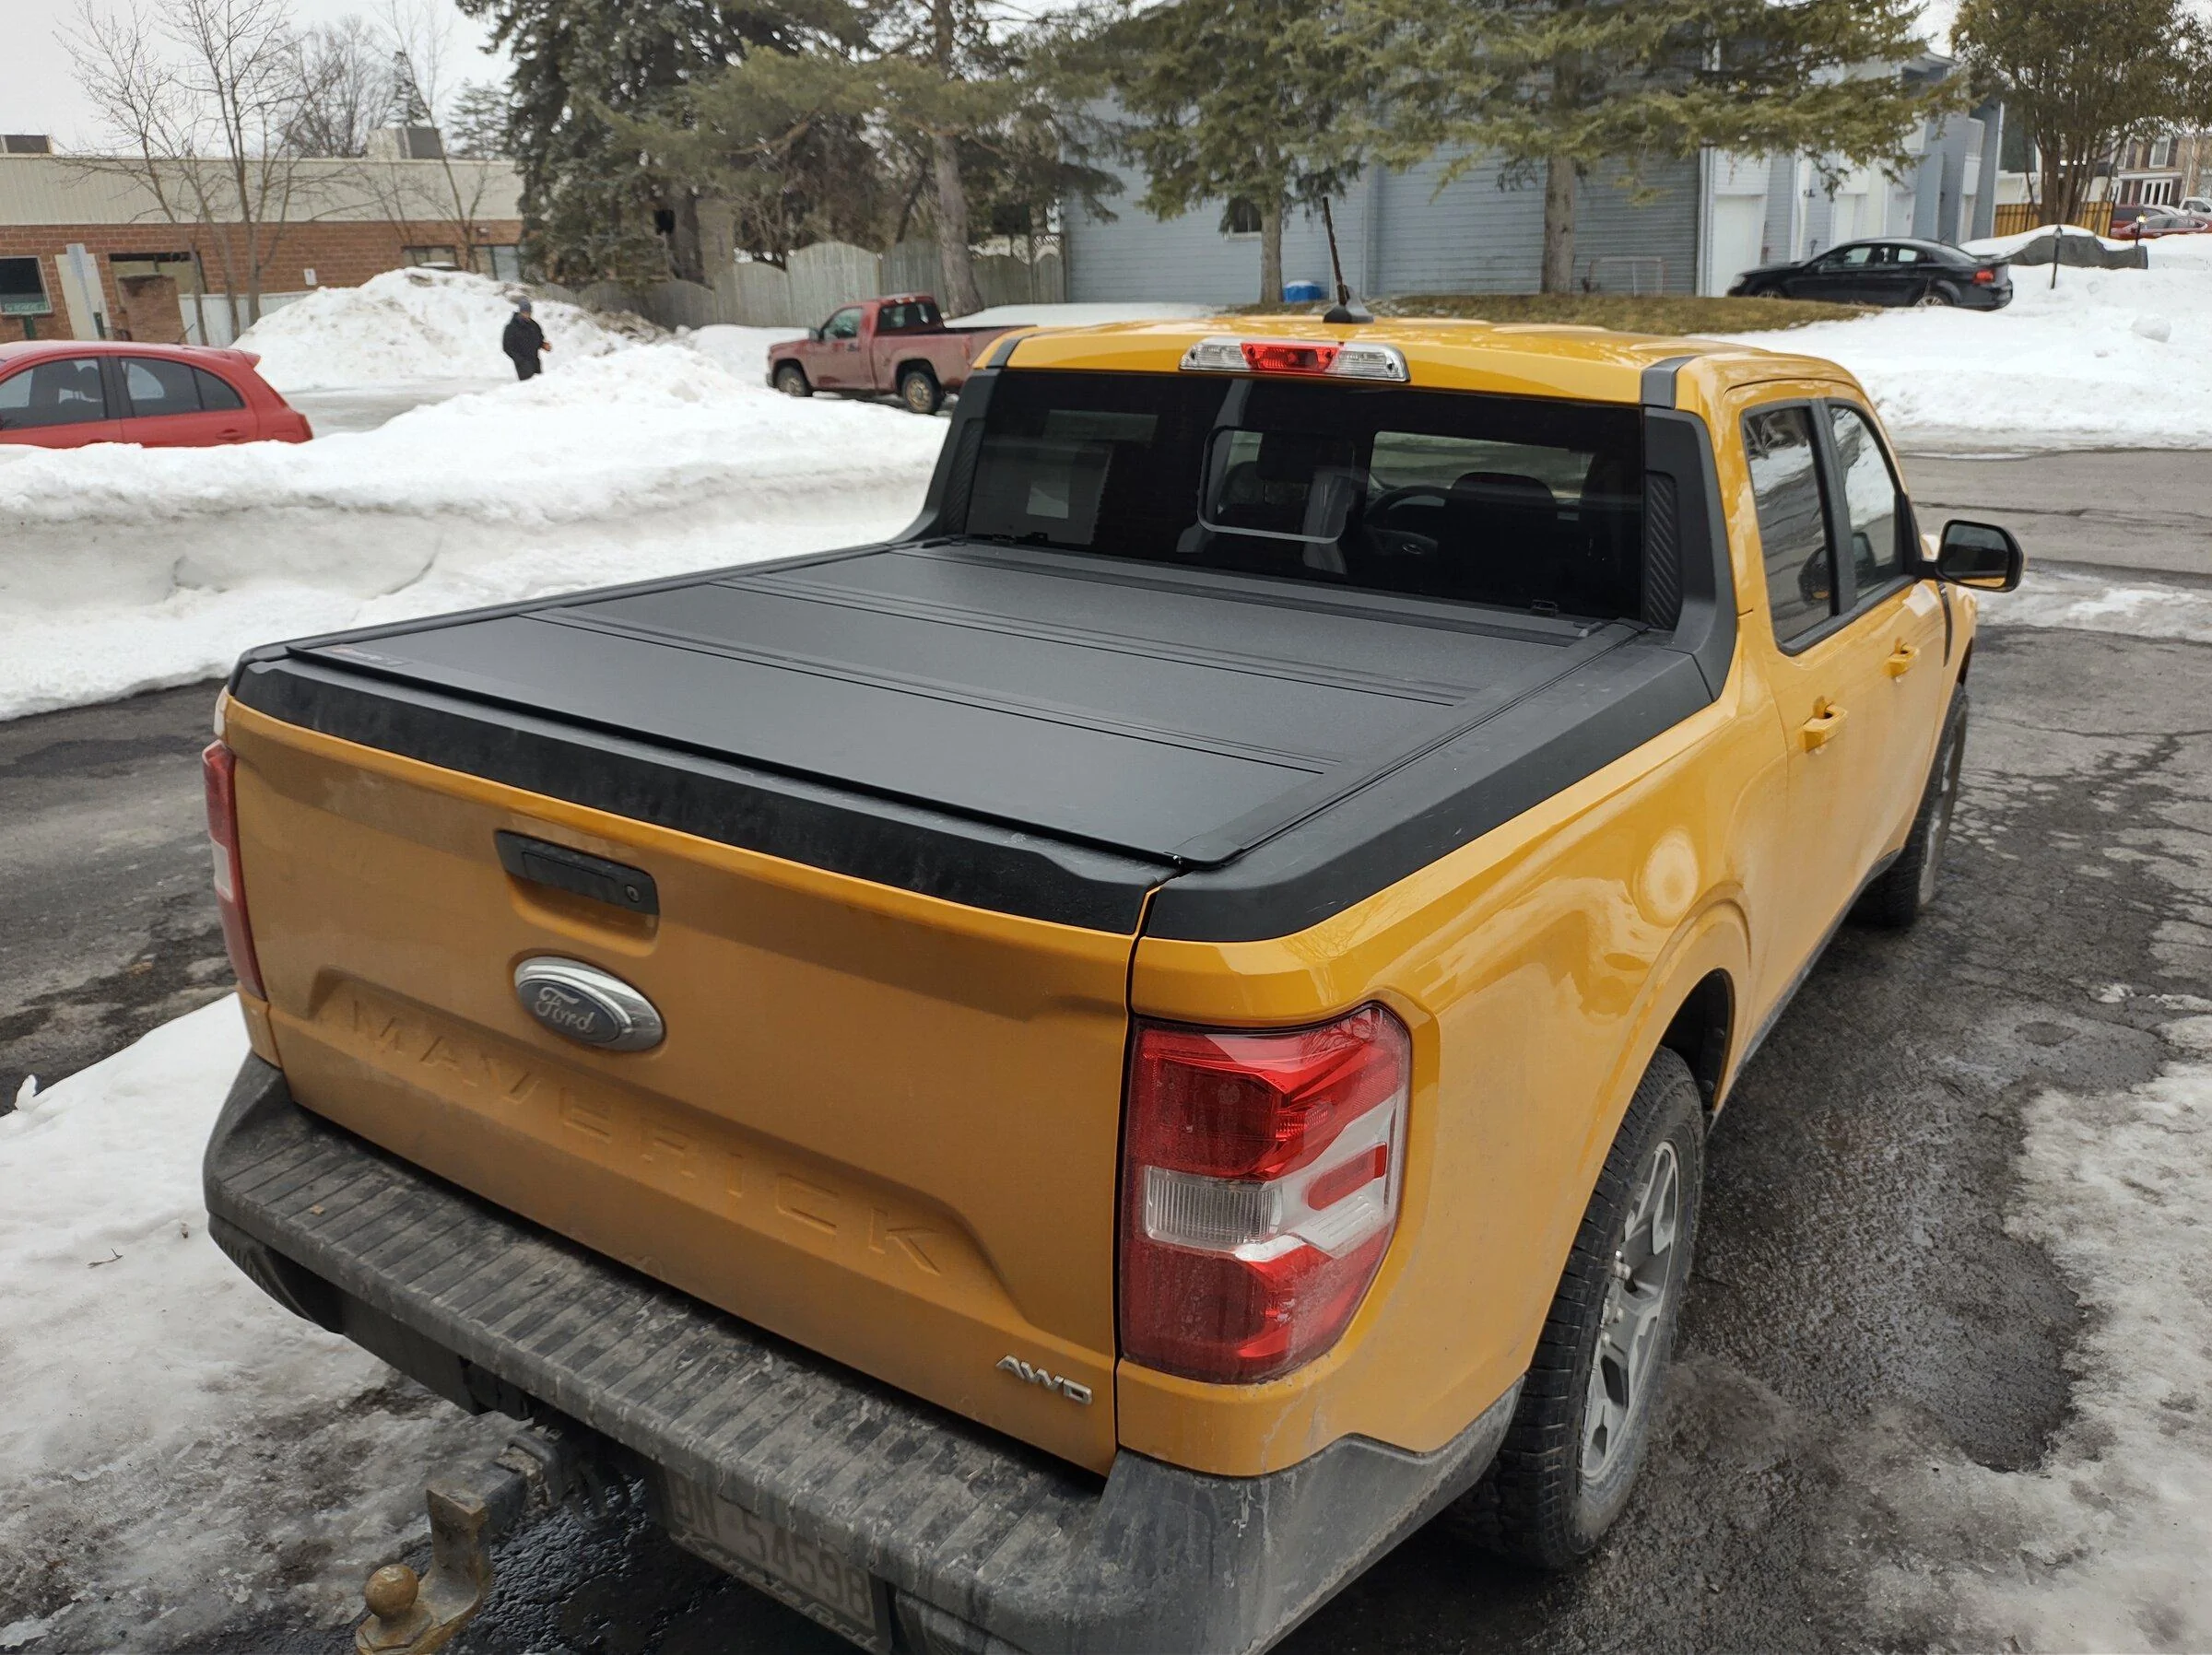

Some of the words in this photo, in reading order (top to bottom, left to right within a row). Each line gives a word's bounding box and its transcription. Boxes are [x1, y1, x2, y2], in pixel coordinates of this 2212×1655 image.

[534, 987, 594, 1034] Ford
[337, 995, 942, 1275] MAVERICK
[994, 1355, 1094, 1405] AWD
